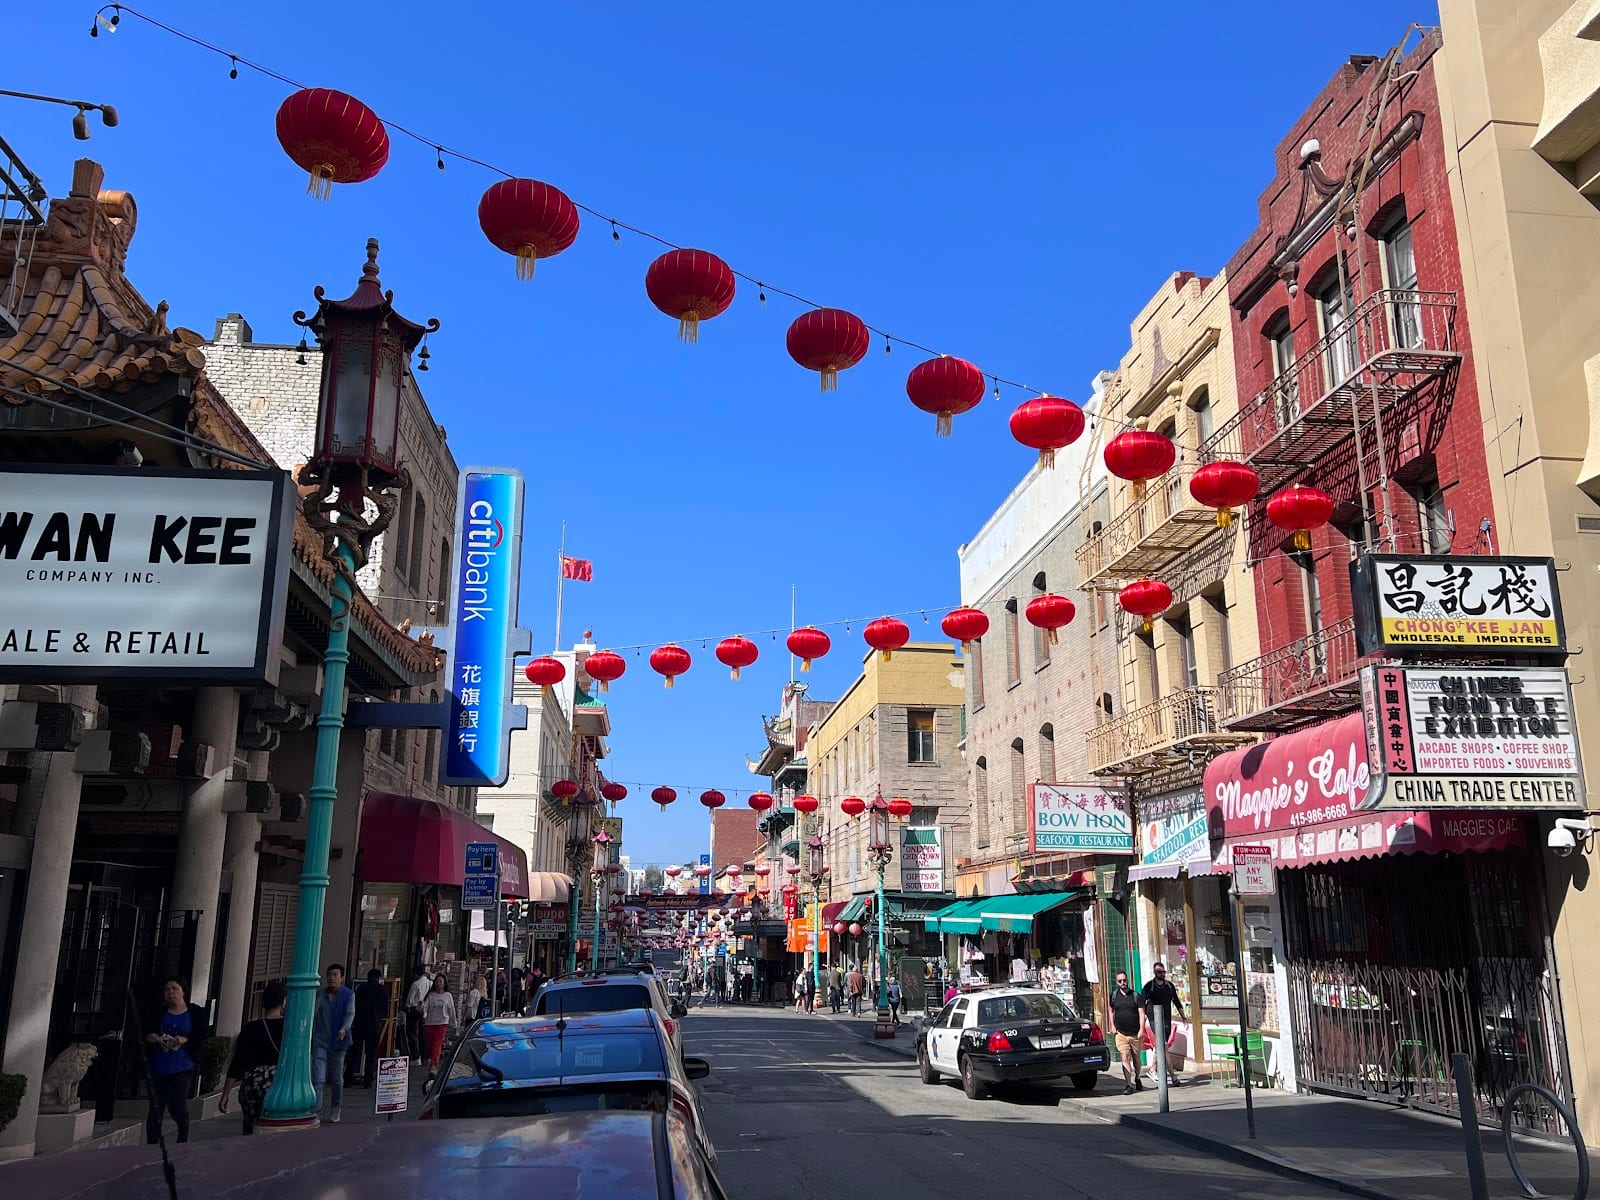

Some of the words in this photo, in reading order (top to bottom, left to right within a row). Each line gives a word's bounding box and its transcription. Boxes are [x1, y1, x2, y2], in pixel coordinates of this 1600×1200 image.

[0, 511, 116, 563] WAN
[148, 514, 257, 565] KEE
[463, 500, 504, 623] citibank
[26, 569, 114, 583] COMPANY
[124, 572, 161, 584] INC.
[1383, 562, 1551, 619] 昌記棧
[1394, 620, 1456, 634] CHONG
[1466, 620, 1499, 634] KEE
[1509, 621, 1544, 634] JAN
[1, 628, 62, 653] ALE
[72, 632, 91, 653] &
[104, 630, 210, 655] RETAIL
[1390, 633, 1465, 643] WHOLESALE
[1476, 635, 1552, 644] IMPORTERS
[1439, 676, 1521, 694] CHINESE
[459, 664, 482, 753] 花旗銀行
[1428, 696, 1557, 714] FURNITURE
[1424, 717, 1556, 735] EXHIBITION
[1418, 742, 1458, 754] ARCADE
[1461, 742, 1494, 754] SHOPS
[1502, 743, 1539, 754] COFFEE
[1542, 743, 1568, 755] SHOP
[1419, 757, 1469, 769] IMPORTED
[1473, 758, 1505, 769] FOODS
[1515, 758, 1571, 769] SOUVENIRS
[1215, 760, 1309, 830] Maggie's
[1308, 742, 1369, 811] Cafe
[1394, 780, 1446, 802] CHINA
[1448, 780, 1506, 802] TRADE
[1509, 781, 1577, 803] CENTER
[1038, 812, 1080, 827] BOW
[1086, 814, 1126, 828] HON
[1289, 803, 1348, 826] 415-986-6668
[1442, 818, 1496, 837] MAGGIE'S
[1036, 834, 1075, 846] SEAFOOD
[1079, 835, 1129, 847] RESTAURANT
[1152, 832, 1186, 863] SEAFOOD
[467, 846, 480, 854] Pay
[1234, 854, 1245, 865] NO
[1246, 856, 1270, 865] STOPPING
[906, 873, 930, 881] GIFTS
[1246, 866, 1261, 875] ANY
[465, 878, 477, 886] Pay
[478, 878, 487, 886] by
[1246, 876, 1264, 885] TIME
[1004, 1028, 1018, 1037] 120
